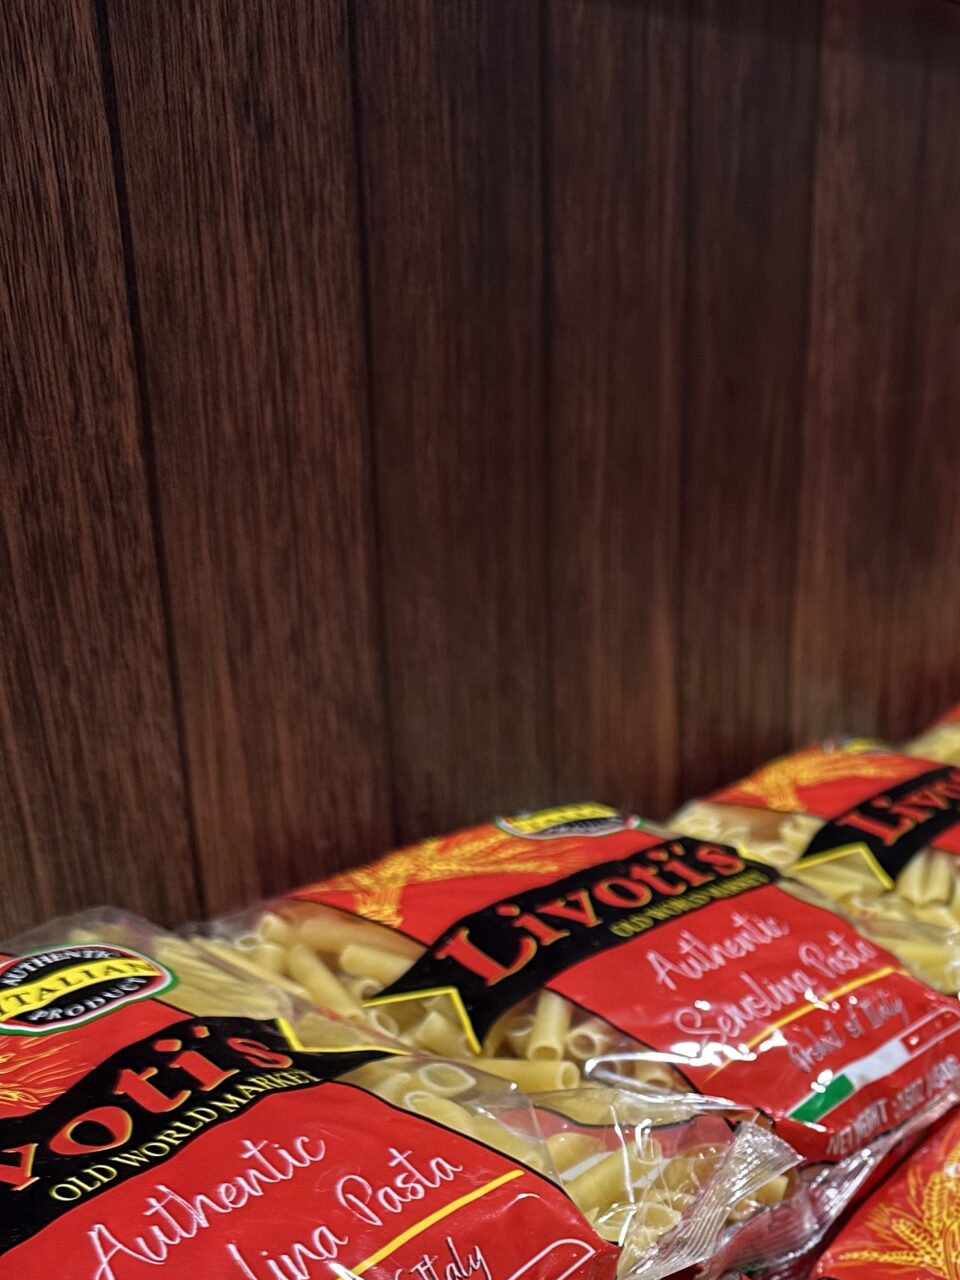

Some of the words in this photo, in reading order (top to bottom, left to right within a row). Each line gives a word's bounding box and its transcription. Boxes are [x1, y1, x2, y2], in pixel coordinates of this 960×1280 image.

[434, 842, 746, 986] Livoti's
[646, 912, 790, 990] Authentic
[50, 1164, 118, 1201] OLD
[112, 1107, 219, 1168] WORLD
[213, 1070, 322, 1114] MARKET
[340, 1147, 464, 1226] Pasta
